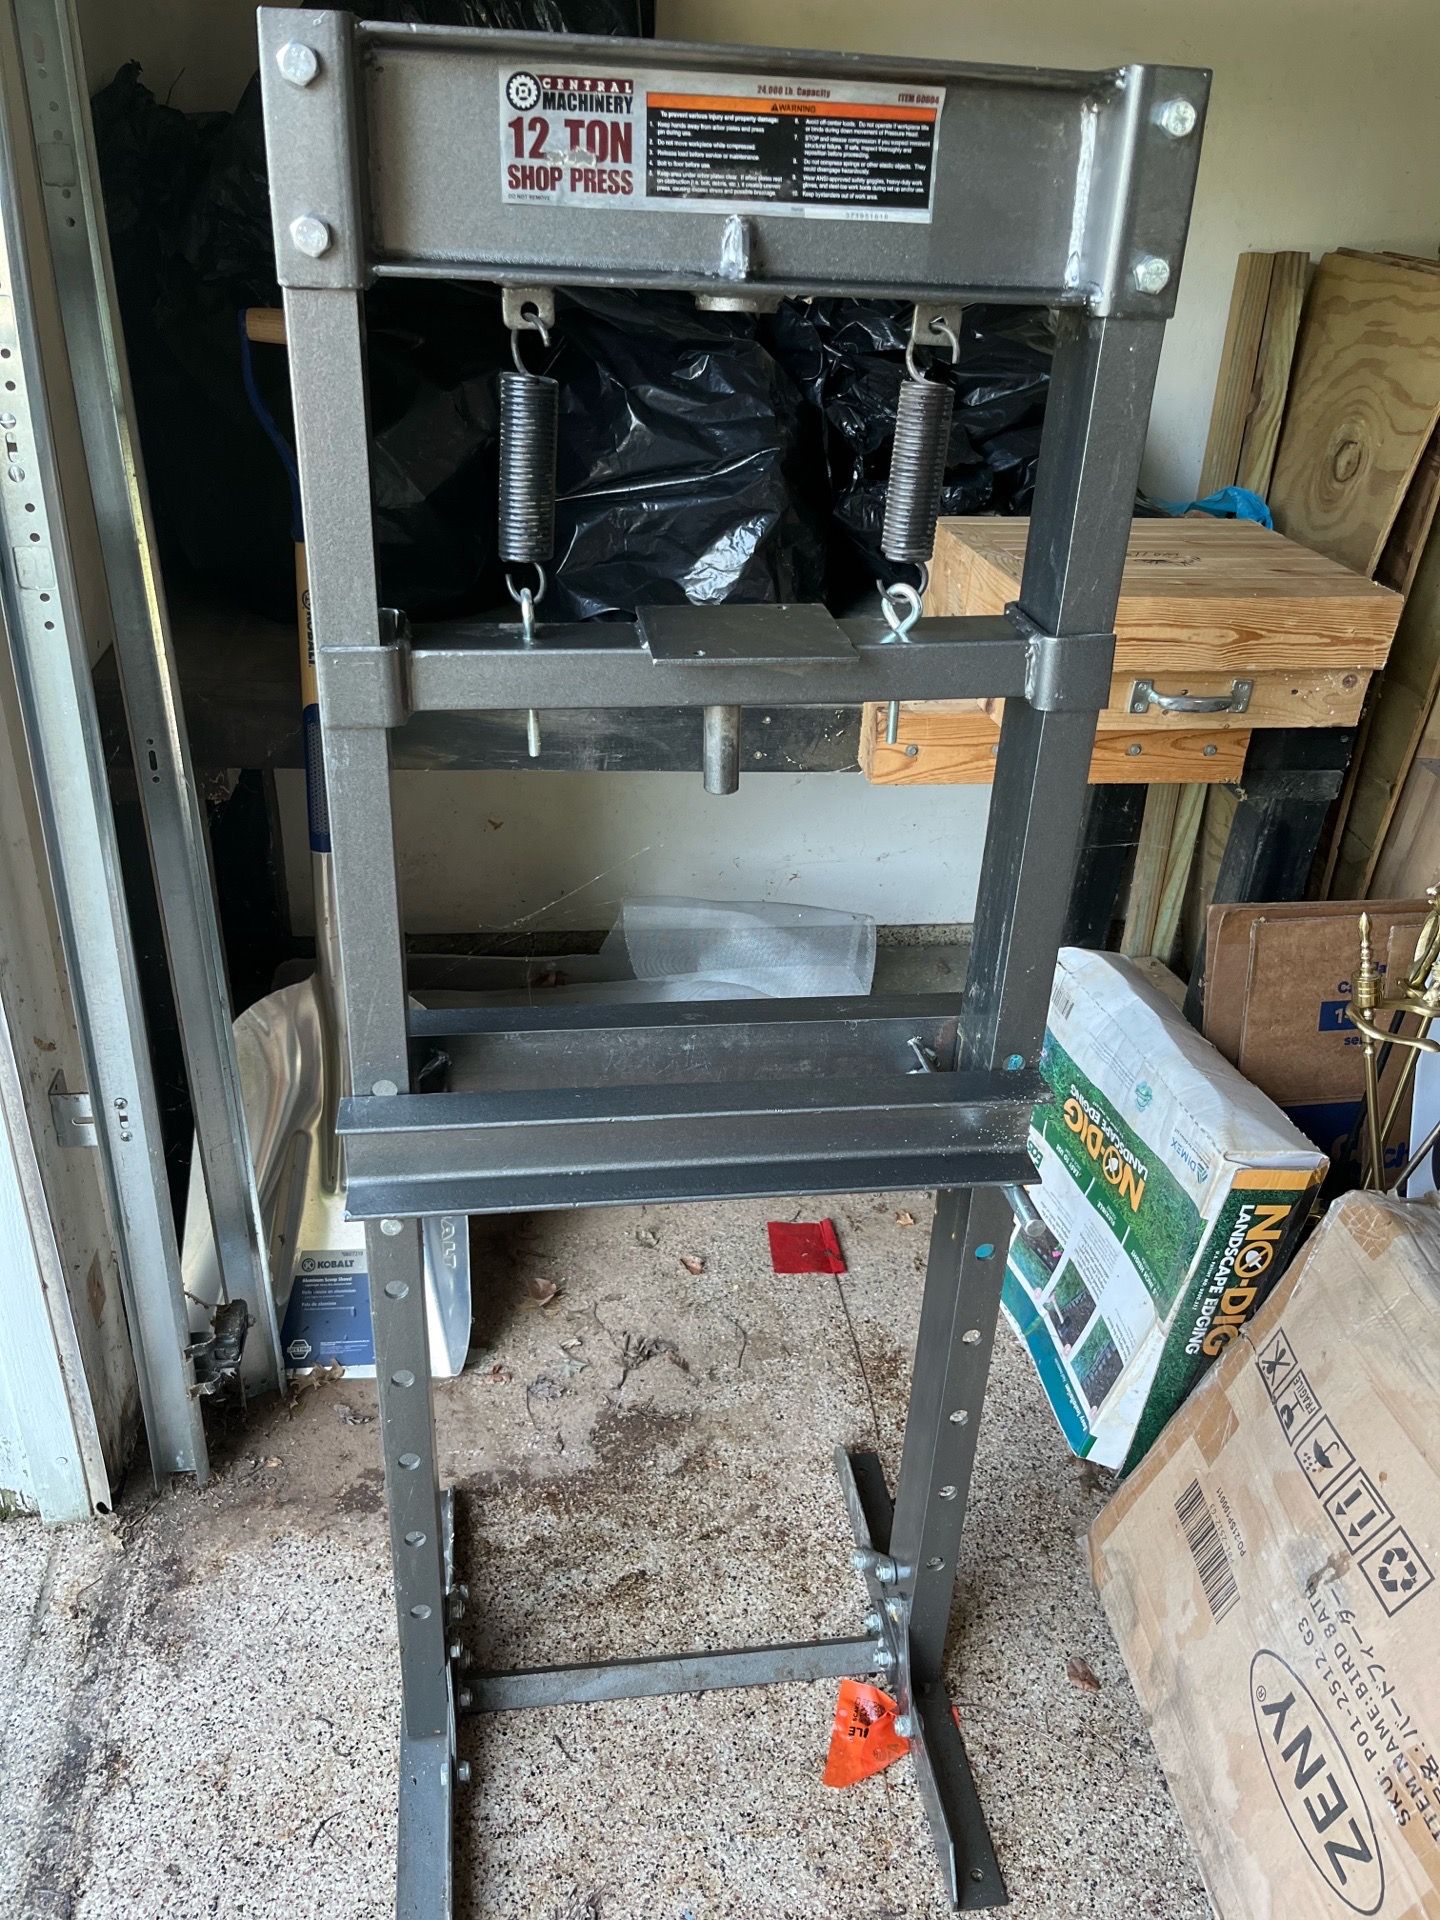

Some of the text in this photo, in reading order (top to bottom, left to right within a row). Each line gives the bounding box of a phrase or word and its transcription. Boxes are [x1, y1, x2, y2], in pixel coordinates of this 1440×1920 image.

[543, 78, 632, 93] CENTRAL
[543, 92, 633, 114] MACHINERY
[797, 88, 830, 98] Capacity
[898, 94, 914, 103] ITEM
[778, 104, 816, 113] WARNING
[508, 117, 632, 164] 12 TON
[508, 164, 633, 195] SHOP PRESS
[1069, 1083, 1101, 1124] EDGING
[1061, 1096, 1145, 1211] NO-DIG
[1101, 1119, 1149, 1180] LANDSCAPE
[1170, 1136, 1196, 1171] DIMEX
[441, 1216, 456, 1268] ALT
[317, 1260, 354, 1268] KOBALT
[1185, 1204, 1254, 1355] LANDSCAPE EDGING
[1201, 1204, 1291, 1354] NO-DIG
[1064, 1383, 1081, 1416] Installation
[1292, 1375, 1315, 1414] FRAGILE
[1302, 1580, 1440, 1841] ITEM NAME:BIRD BATH
[1260, 1691, 1375, 1886] ZENY
[1374, 1766, 1413, 1827] SKU:
